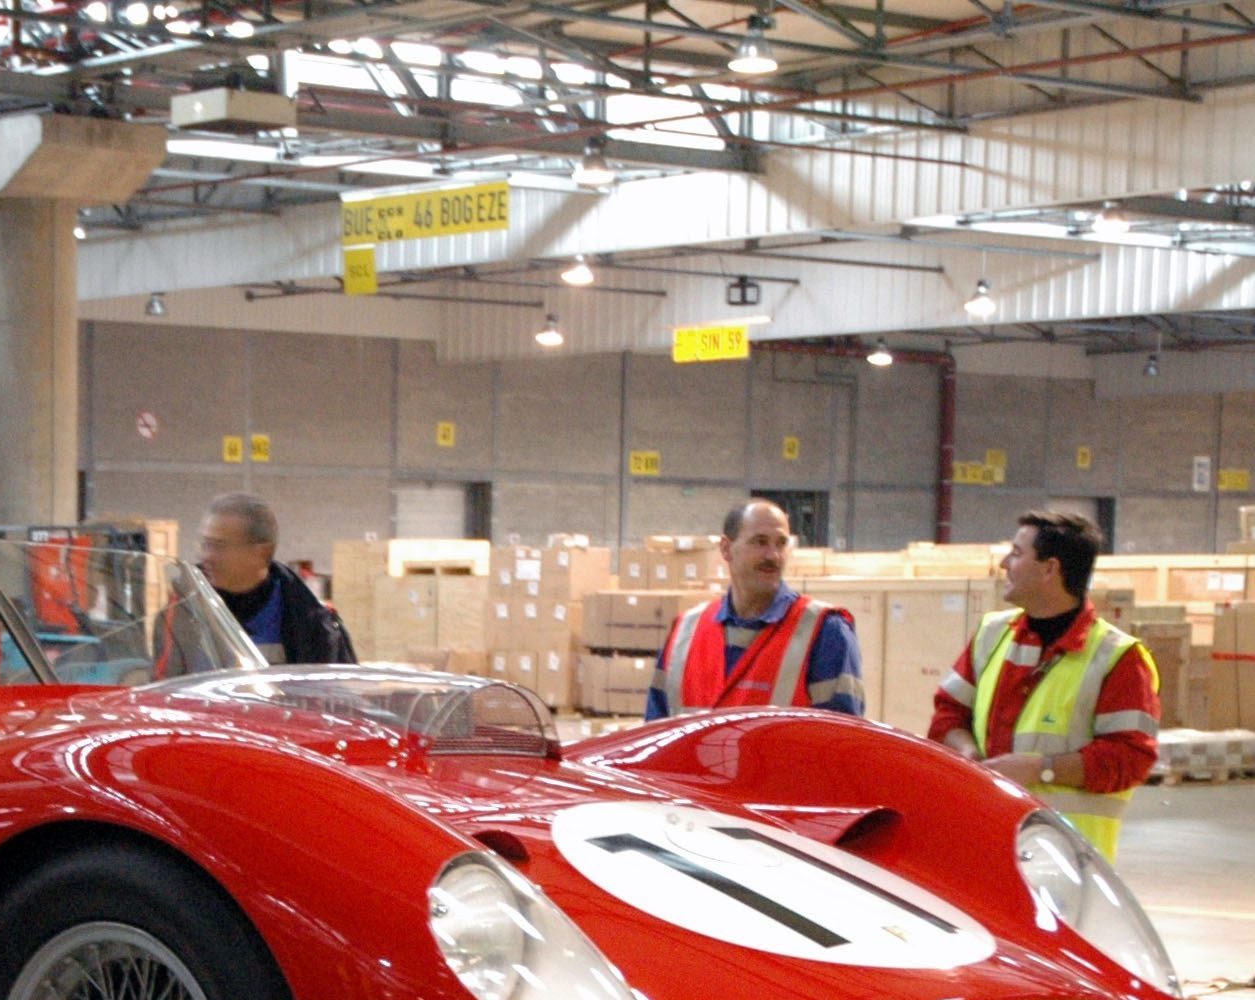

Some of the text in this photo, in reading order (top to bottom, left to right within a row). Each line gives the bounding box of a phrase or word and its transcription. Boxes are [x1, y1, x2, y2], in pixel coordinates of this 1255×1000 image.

[344, 206, 373, 237] BUE
[414, 201, 433, 230] 46
[700, 332, 720, 352] SIN
[728, 330, 742, 350] 59
[584, 826, 962, 949] 11
